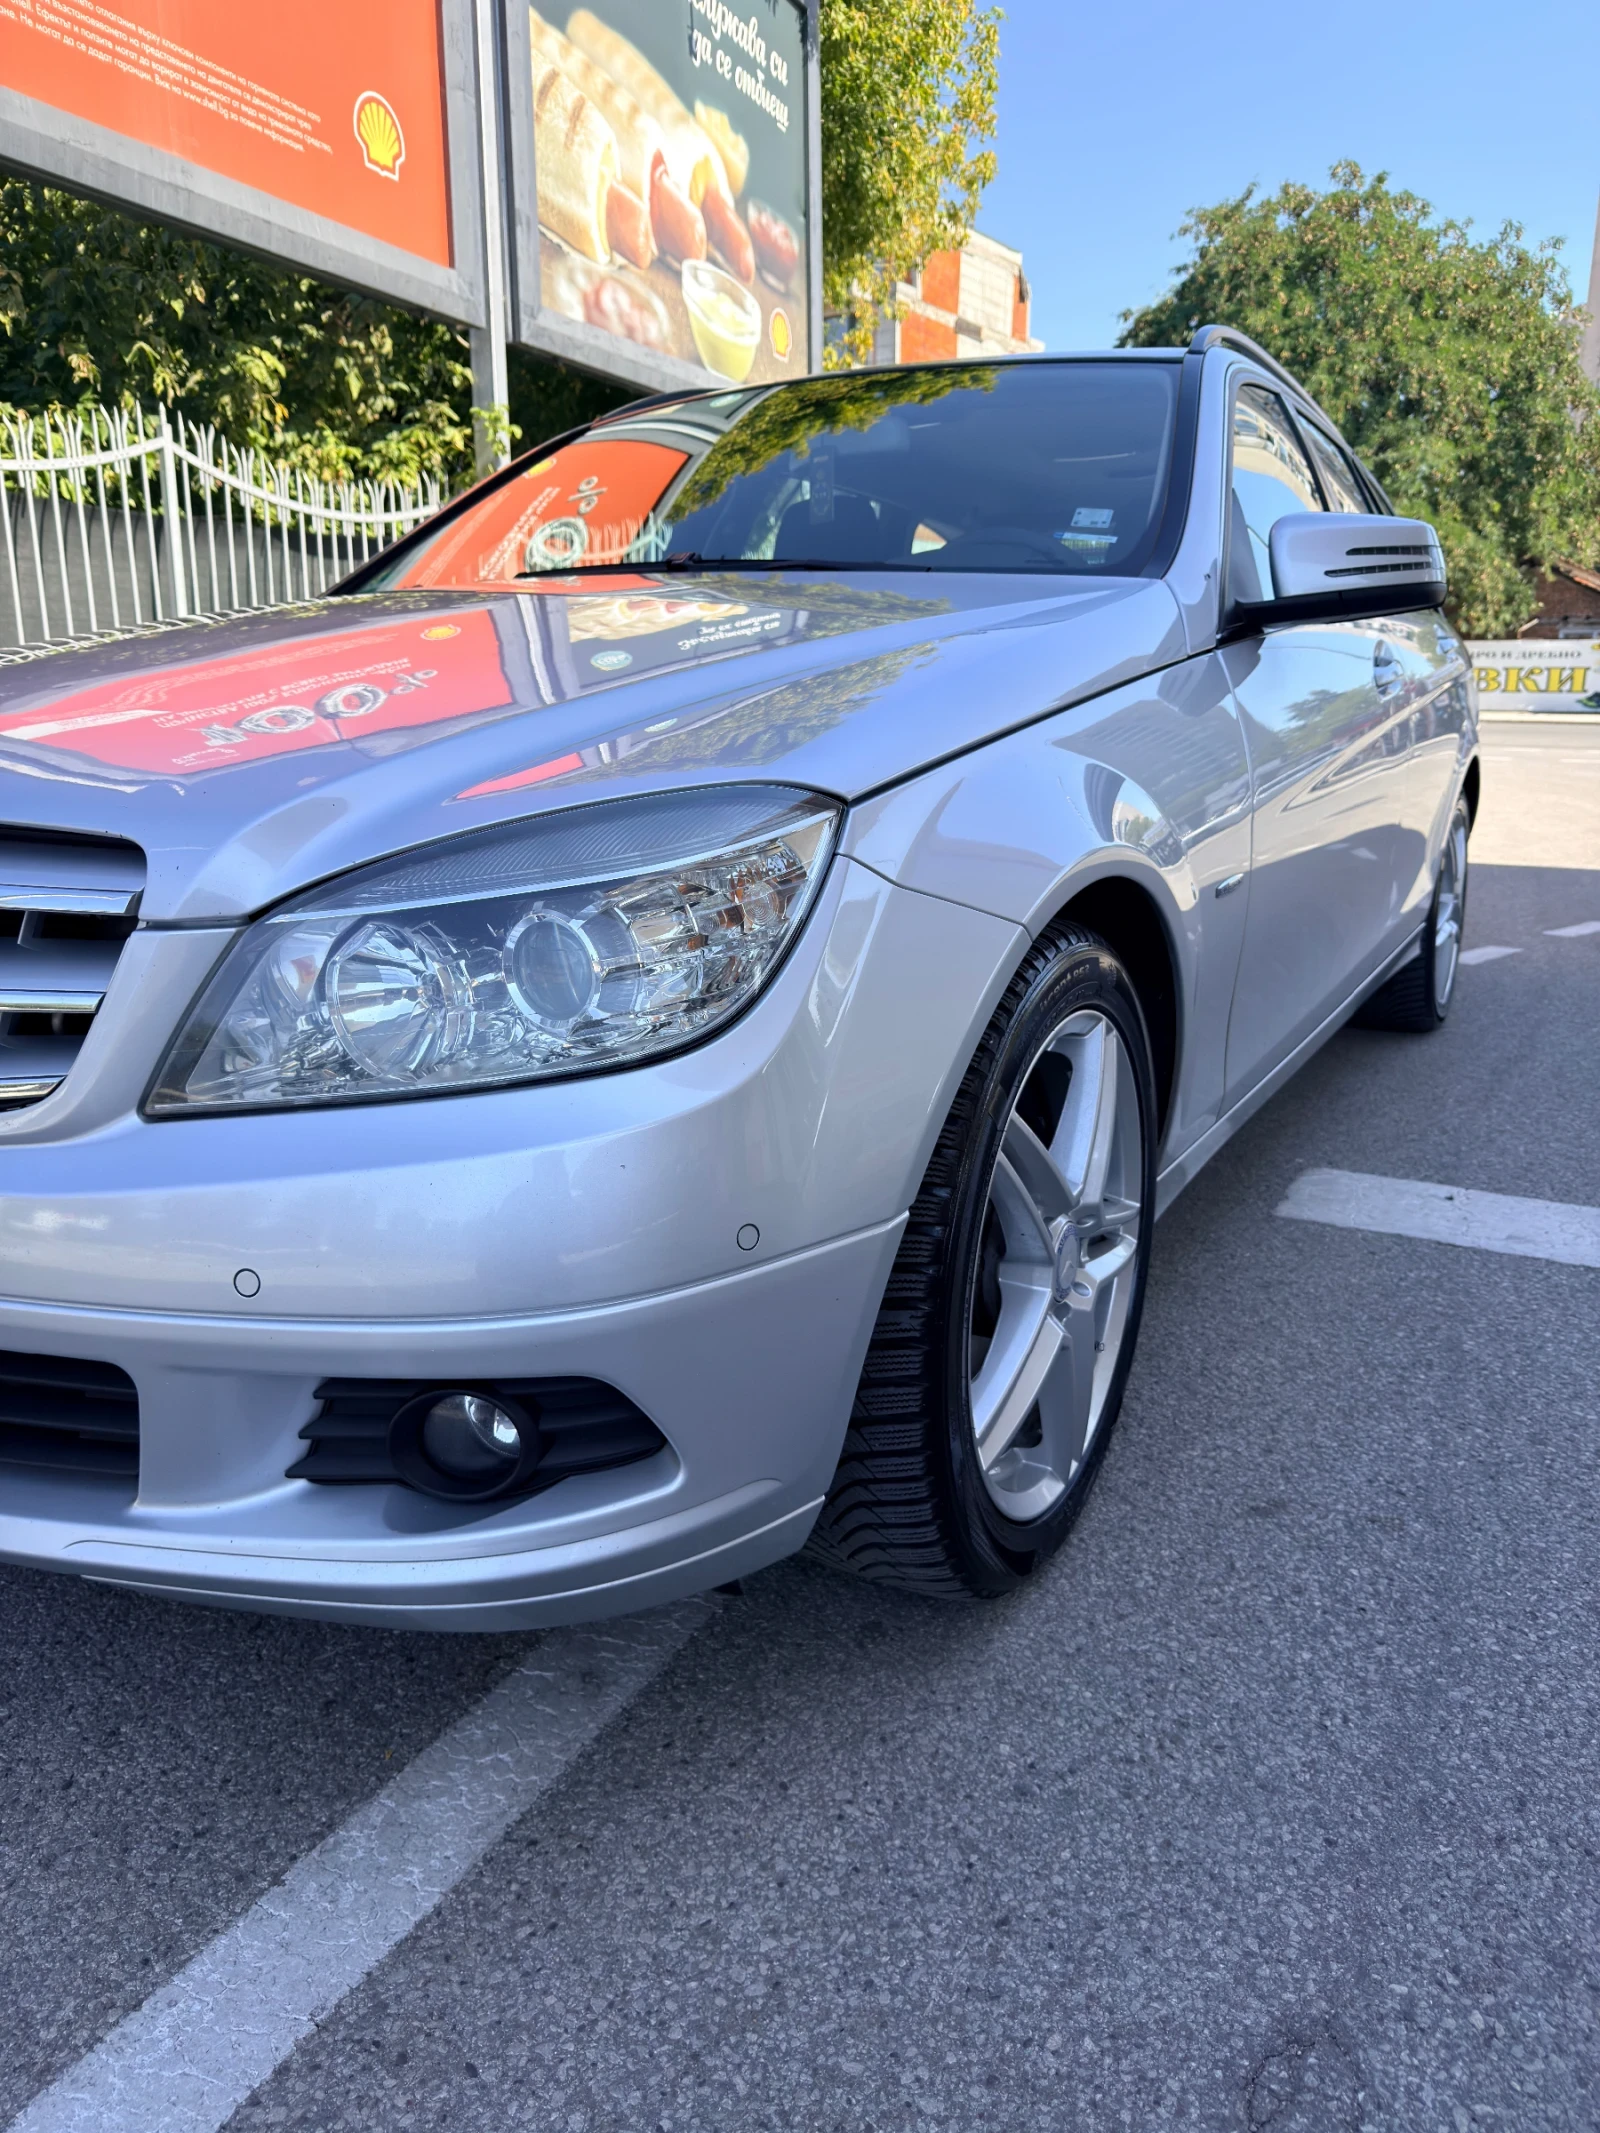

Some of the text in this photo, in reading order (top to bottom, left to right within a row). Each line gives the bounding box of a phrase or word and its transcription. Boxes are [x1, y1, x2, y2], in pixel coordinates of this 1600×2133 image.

[19, 11, 34, 28] Не
[35, 22, 61, 40] могат
[62, 34, 75, 47] да
[76, 41, 87, 53] се
[87, 46, 112, 65] дадат
[154, 73, 171, 91] Виж
[172, 84, 181, 96] на
[35, 3, 71, 30] Ефектът
[73, 24, 79, 34] и
[80, 27, 113, 49] ползите
[115, 44, 138, 60] могат
[139, 55, 150, 67] да
[151, 61, 183, 80] варират
[190, 79, 231, 104] зависимост
[231, 99, 240, 109] от
[52, 0, 128, 41] възстановяването
[129, 36, 139, 48] на
[141, 42, 196, 75] представянето
[197, 69, 206, 80] на
[207, 74, 242, 97] двигателя
[95, 5, 136, 31] отлагания
[137, 26, 160, 46] върху
[161, 38, 194, 60] ключови
[195, 55, 236, 81] компоненти
[691, 28, 789, 133] да се отбиеш
[769, 51, 789, 87] си
